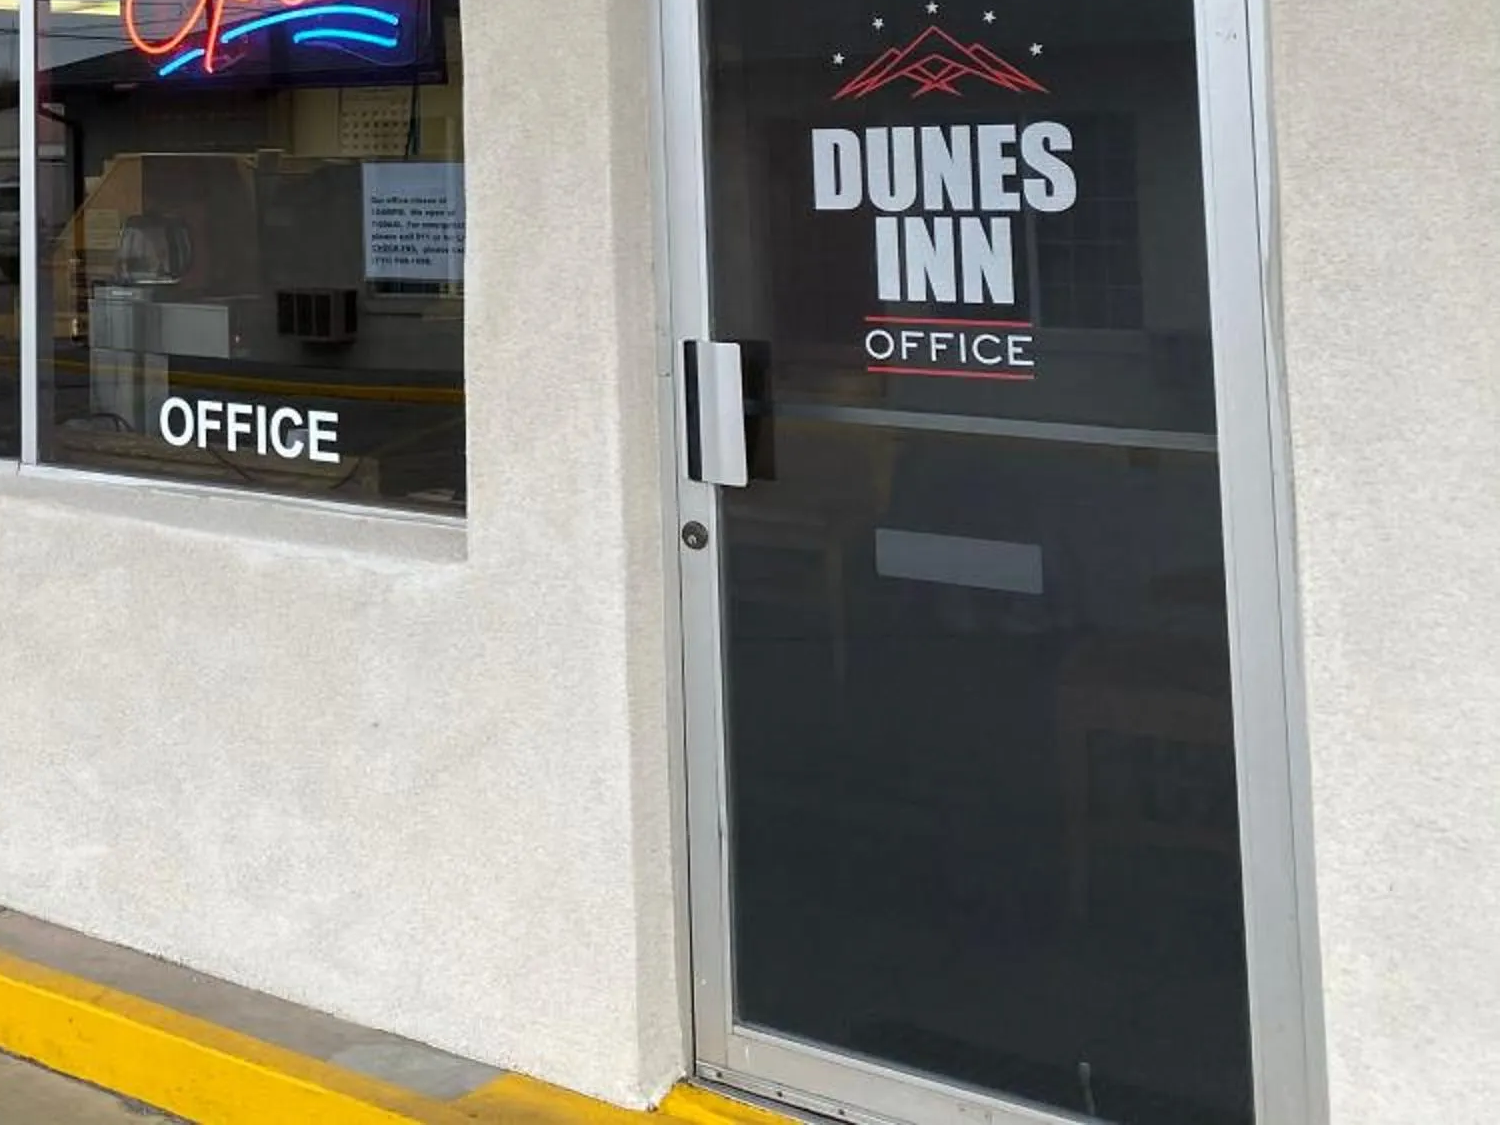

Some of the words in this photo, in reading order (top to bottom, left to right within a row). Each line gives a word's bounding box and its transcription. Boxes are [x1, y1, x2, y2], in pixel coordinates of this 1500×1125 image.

[811, 121, 1077, 212] DUNES
[875, 216, 1016, 305] INN
[864, 328, 1036, 366] OFFICE
[159, 396, 341, 464] OFFICE
